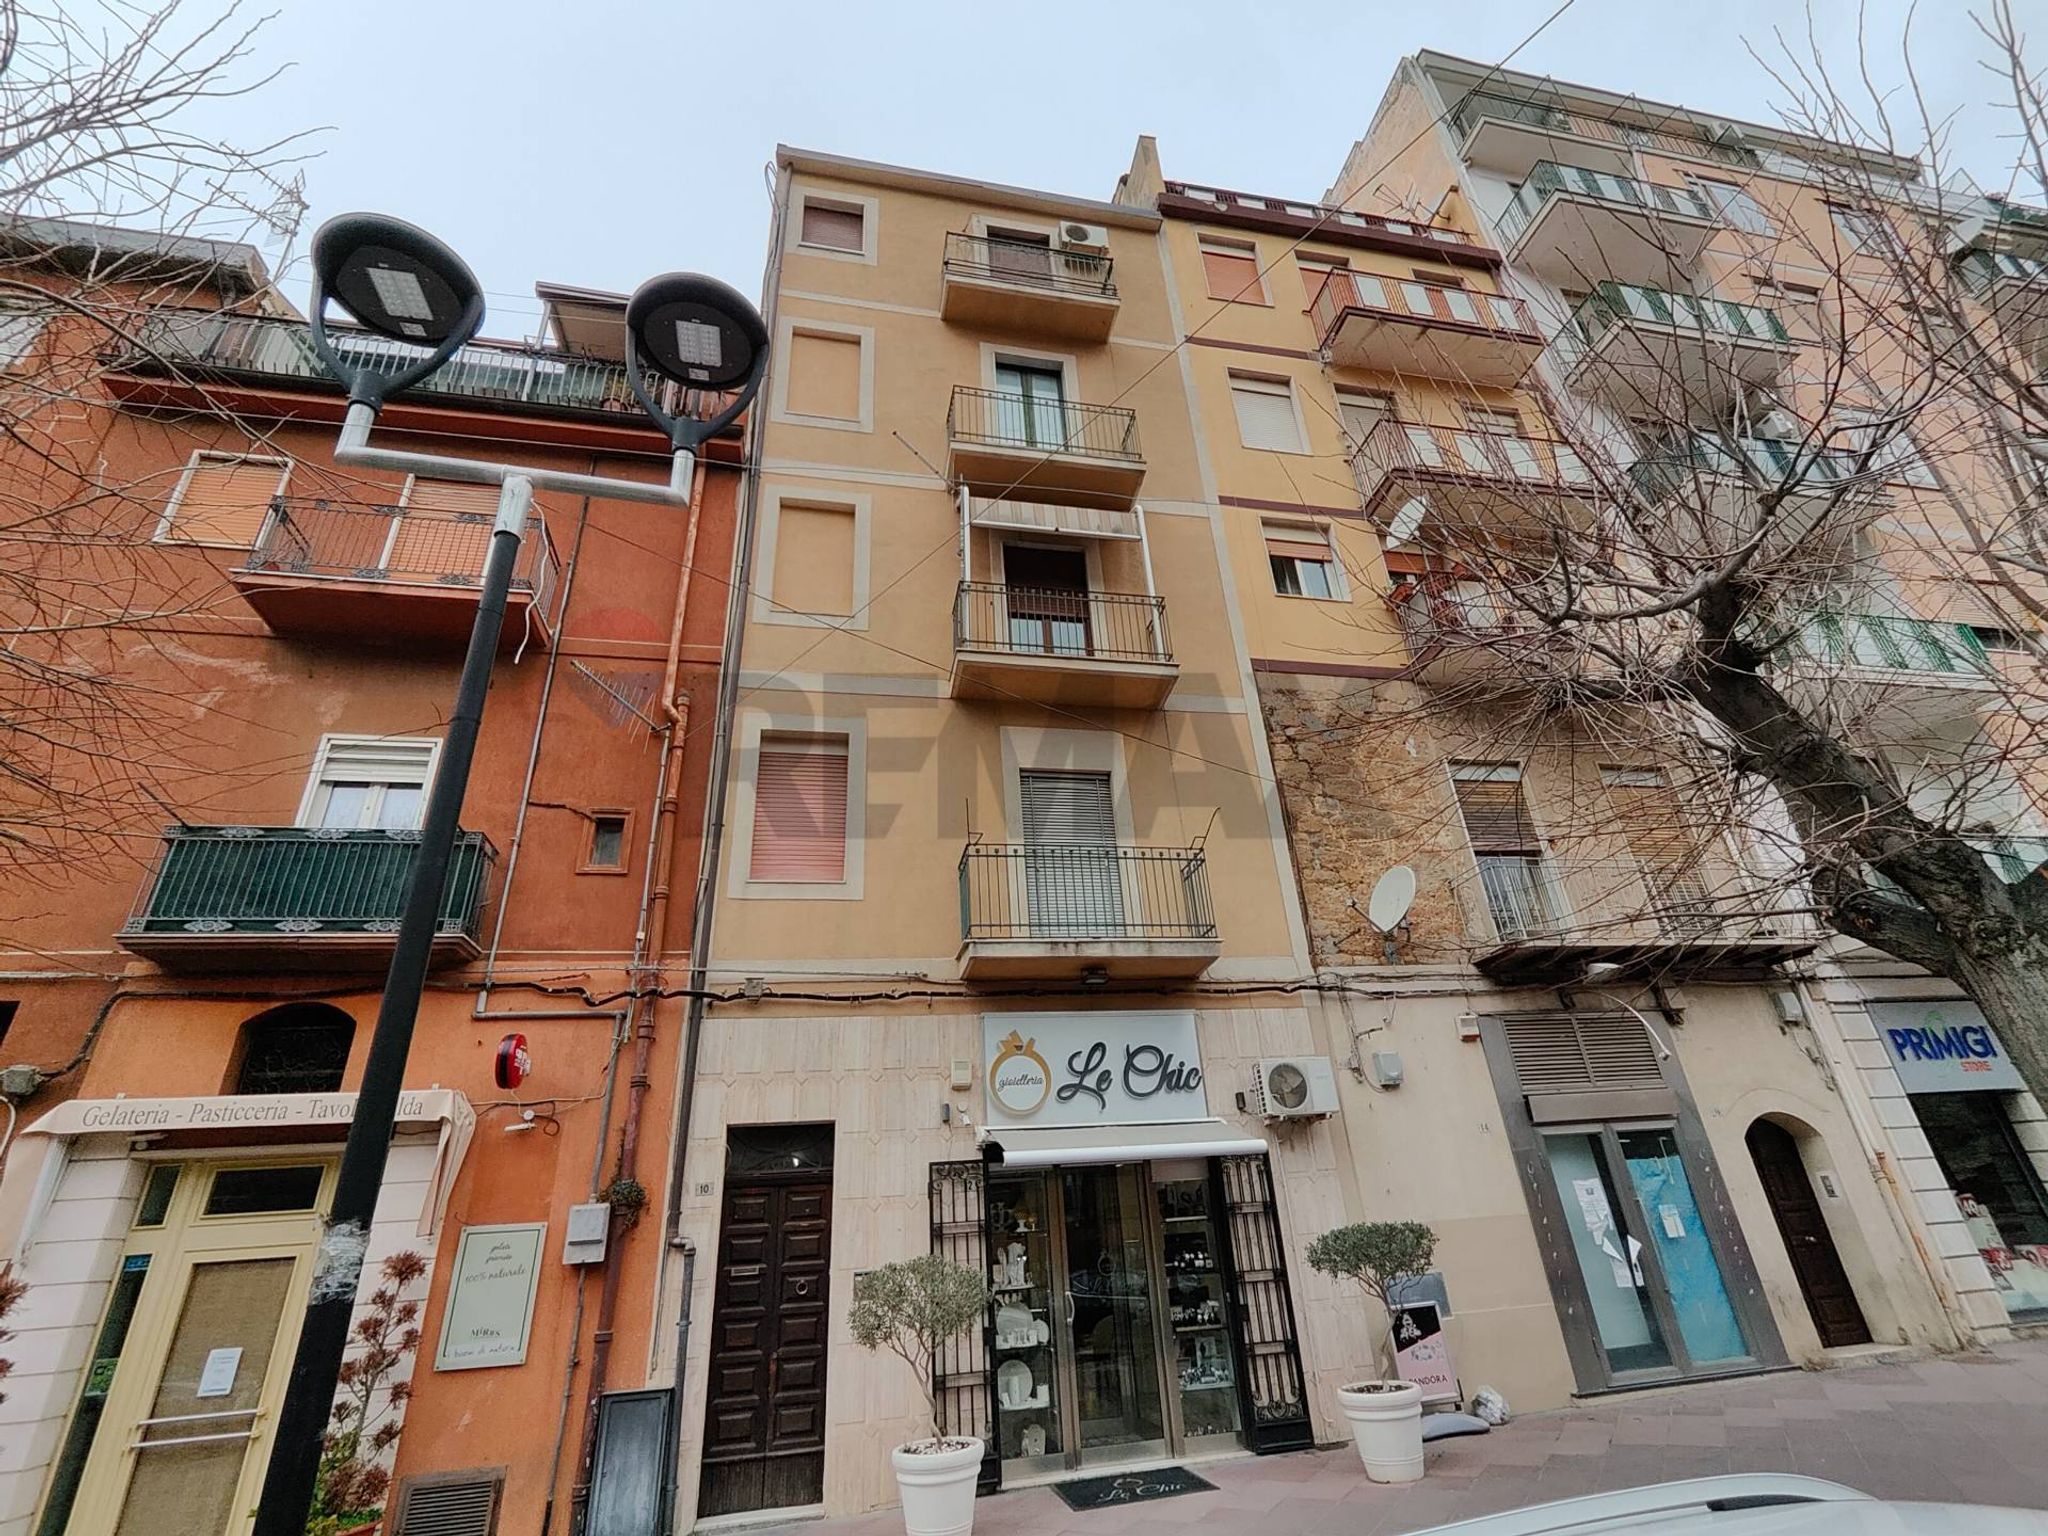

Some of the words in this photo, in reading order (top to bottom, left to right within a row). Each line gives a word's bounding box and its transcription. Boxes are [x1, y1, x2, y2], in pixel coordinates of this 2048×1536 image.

[1887, 1025, 1998, 1061] PRIMIGI
[1056, 1041, 1113, 1111] Le
[1123, 1043, 1202, 1098] Chic
[1960, 1060, 1991, 1072] STORE
[998, 1072, 1044, 1091] gioielleria
[83, 1104, 170, 1127] Gelateria
[188, 1101, 289, 1123] Pasticceria
[309, 1098, 359, 1119] Tavol
[700, 1184, 710, 1195] 10
